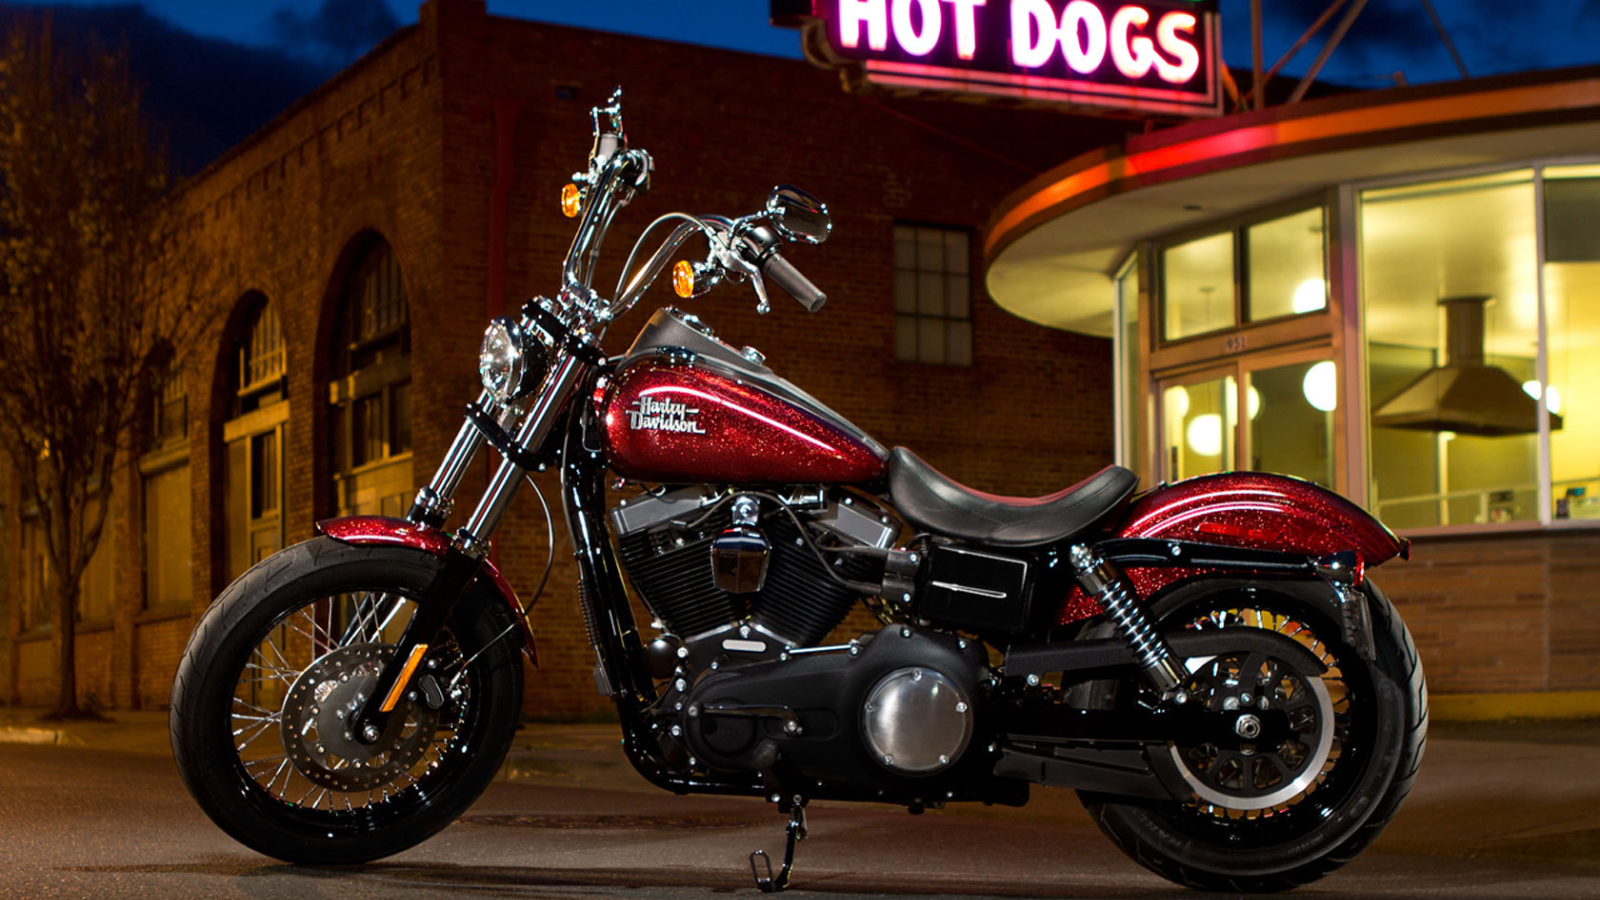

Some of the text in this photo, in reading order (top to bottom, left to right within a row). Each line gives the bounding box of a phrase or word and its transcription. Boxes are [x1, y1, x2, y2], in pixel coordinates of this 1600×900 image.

[838, 0, 1200, 84] HOT DOGS
[632, 396, 699, 420] Harley
[625, 410, 706, 434] Davidson
